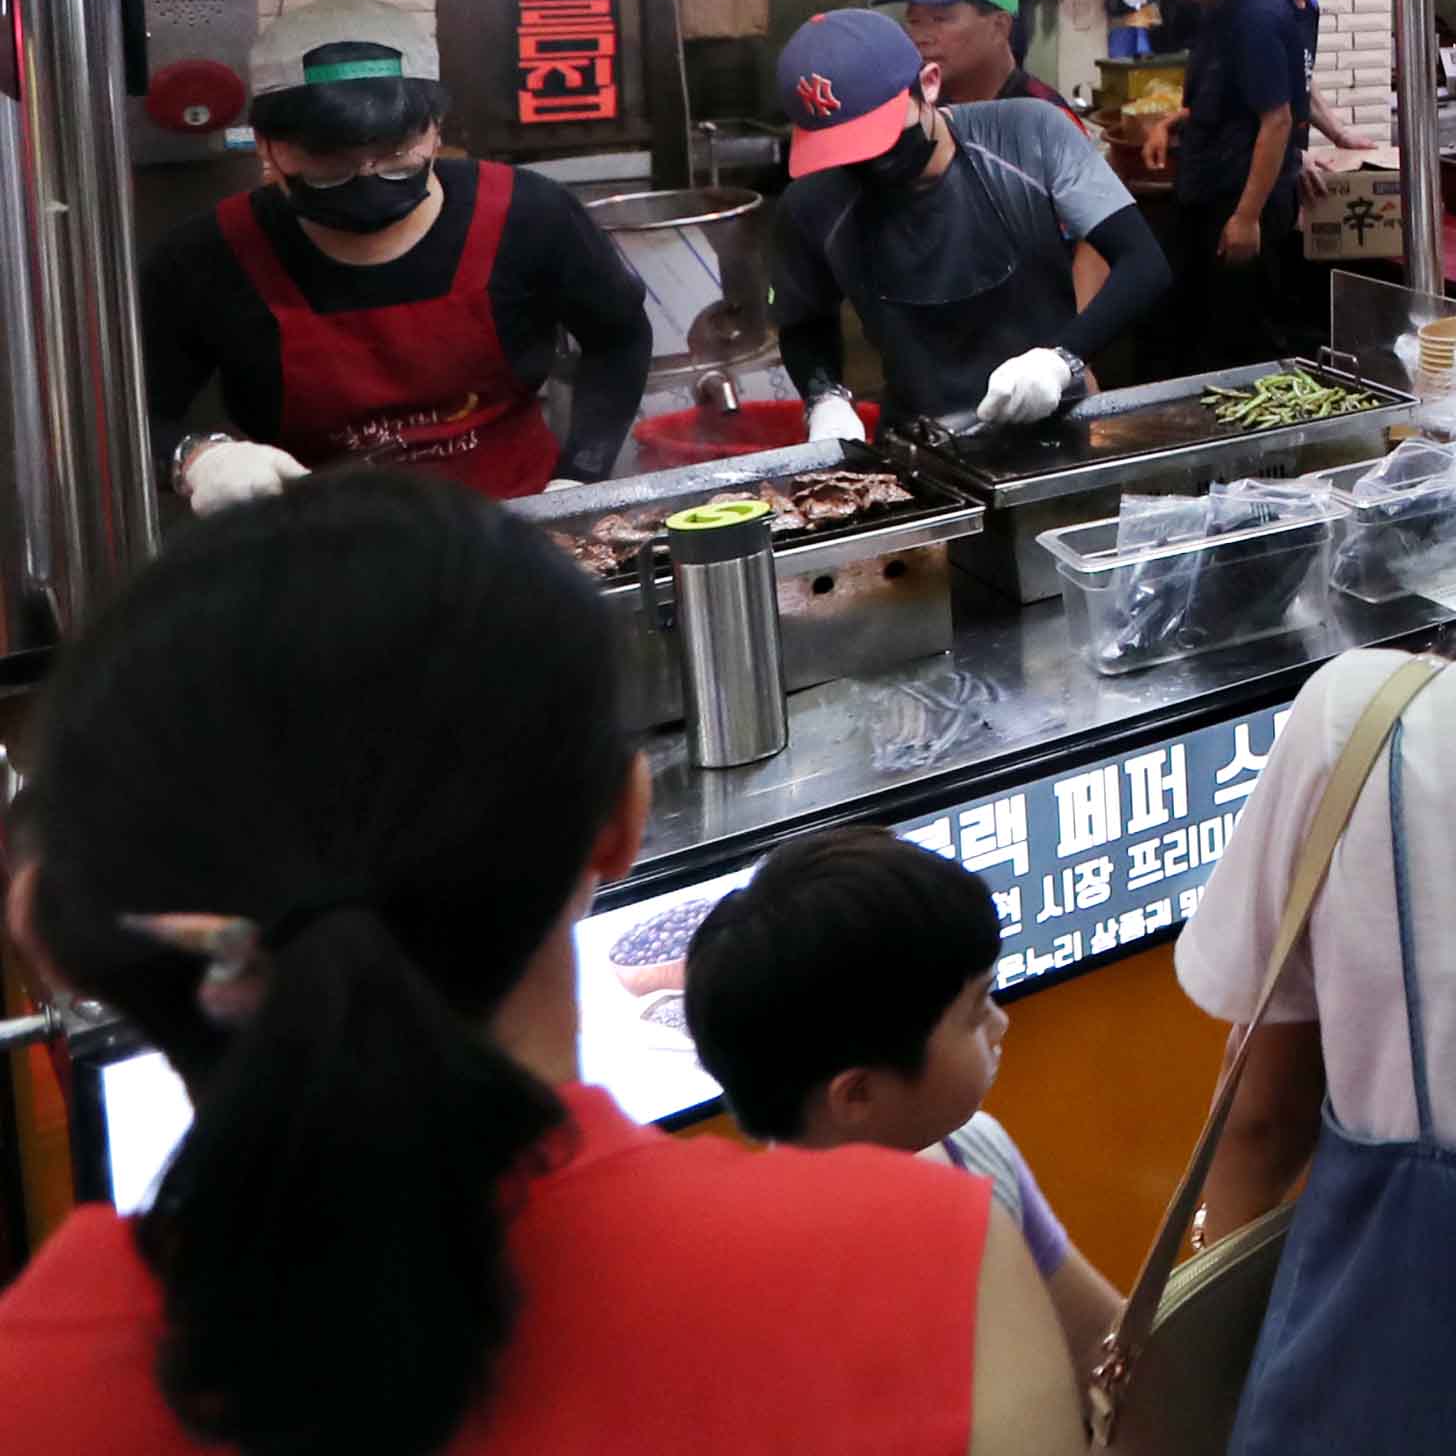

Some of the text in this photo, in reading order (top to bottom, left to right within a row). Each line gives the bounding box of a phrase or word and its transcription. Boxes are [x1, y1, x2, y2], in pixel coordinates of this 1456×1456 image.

[1053, 744, 1189, 858] 페퍼
[1213, 709, 1291, 806] 스
[1036, 856, 1114, 924] 시장
[1126, 809, 1243, 891] 프리미
